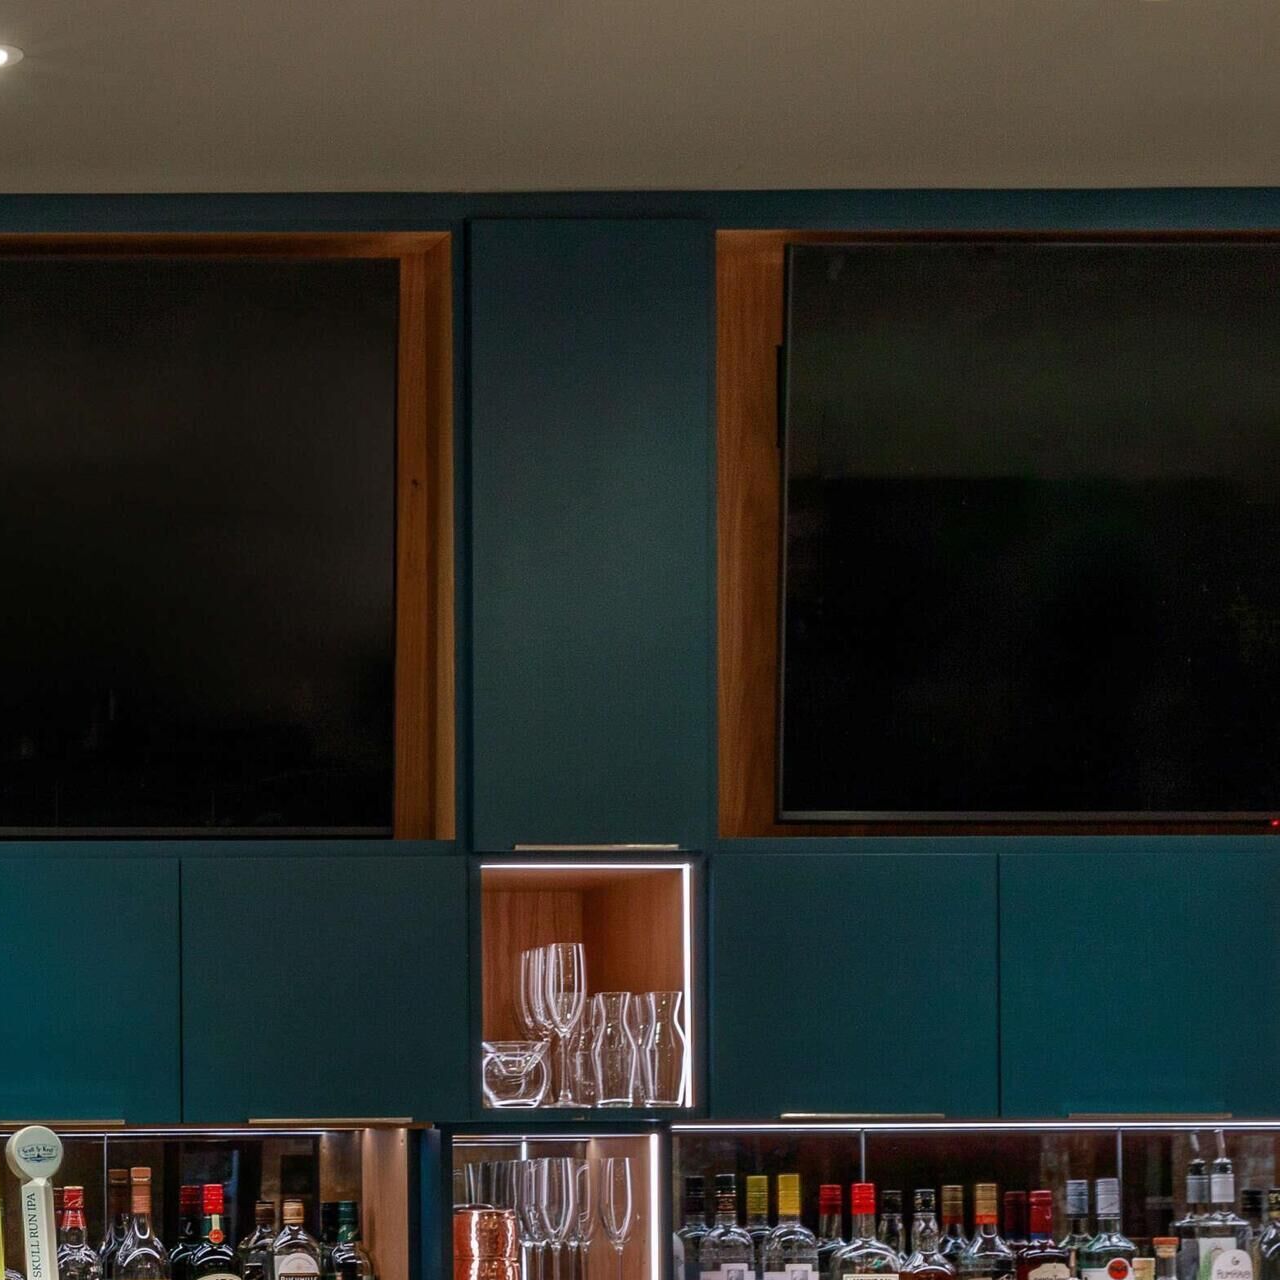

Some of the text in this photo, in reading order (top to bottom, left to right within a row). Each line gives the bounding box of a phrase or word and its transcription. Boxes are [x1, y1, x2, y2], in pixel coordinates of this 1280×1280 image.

[27, 1192, 42, 1278] SKULL RUN IPA
